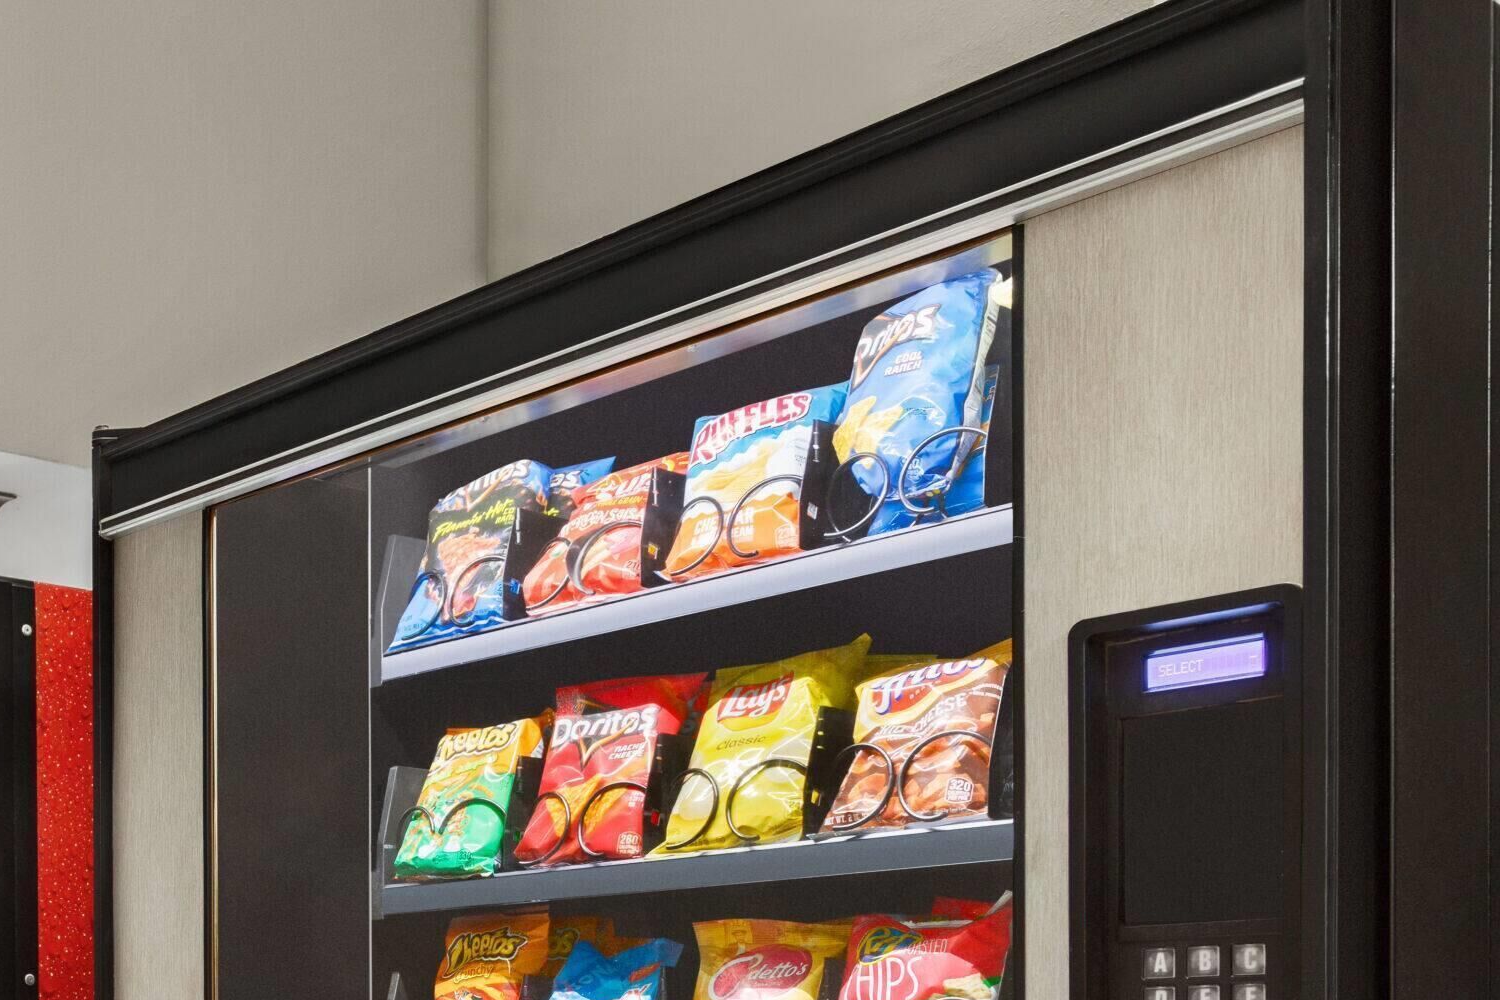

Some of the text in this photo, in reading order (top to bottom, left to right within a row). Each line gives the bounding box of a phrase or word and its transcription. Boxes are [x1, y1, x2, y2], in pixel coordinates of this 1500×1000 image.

[854, 304, 940, 363] oritos
[692, 394, 810, 463] RUFFLES
[1158, 658, 1205, 678] SELECT
[552, 706, 659, 748] Doritos
[948, 779, 971, 792] 320
[905, 938, 948, 955] OASTED
[1154, 948, 1257, 973] A B C
